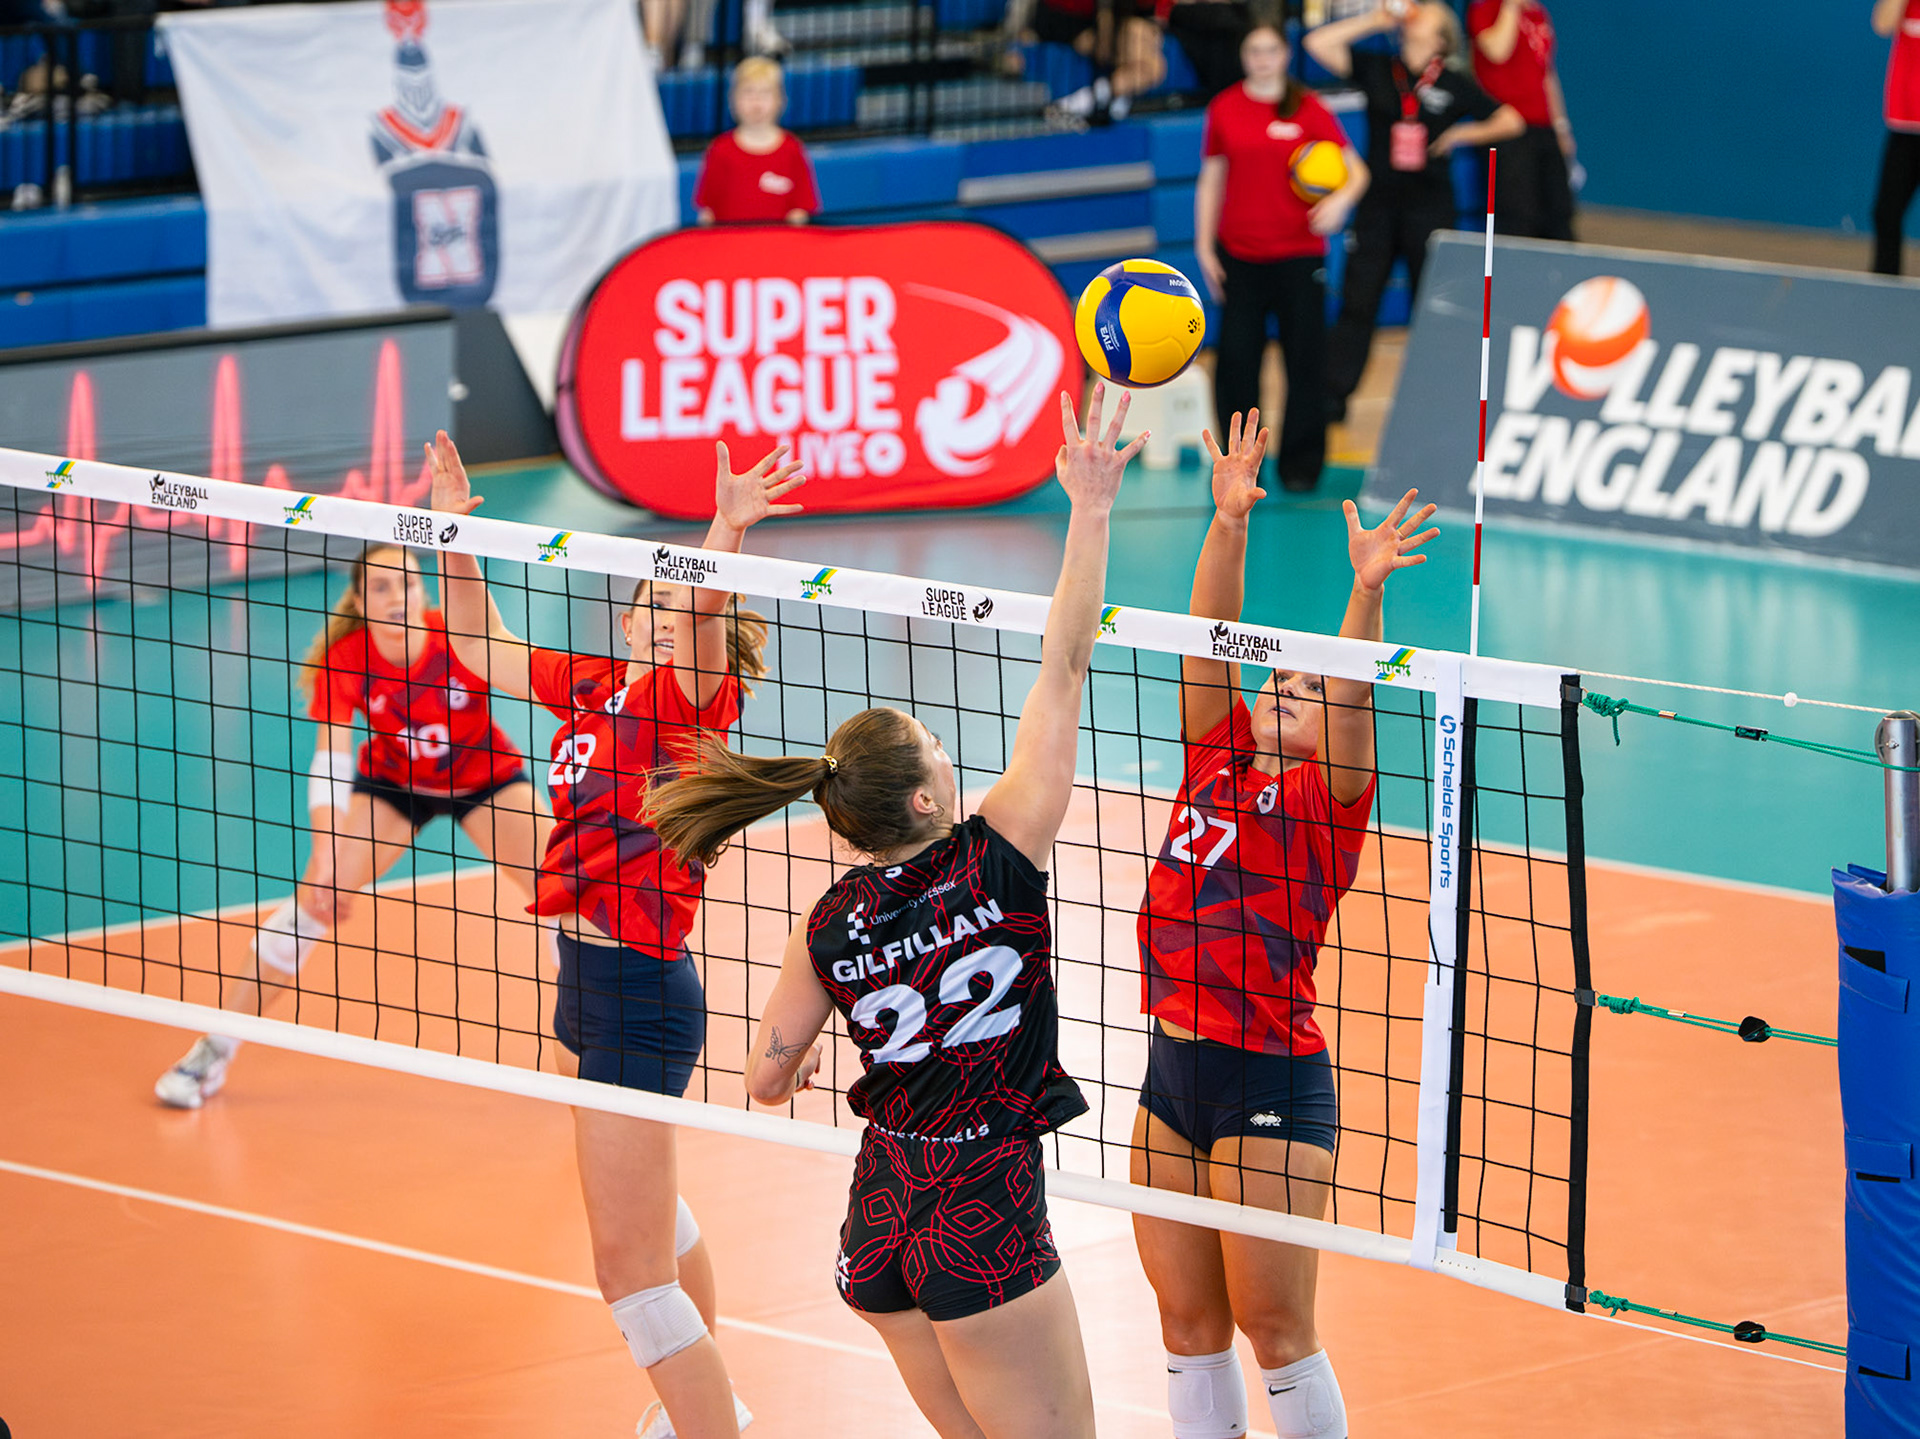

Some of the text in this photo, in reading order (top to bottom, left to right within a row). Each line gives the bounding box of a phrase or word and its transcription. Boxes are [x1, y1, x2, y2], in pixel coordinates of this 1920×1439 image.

[654, 276, 897, 358] SUPER
[621, 354, 901, 442] LEAGUE
[149, 474, 209, 500] VOLLEYBALL
[1467, 411, 1871, 538] ENGLAND
[151, 492, 198, 510] ENGLAND
[397, 512, 433, 531] SUPER
[393, 526, 434, 546] LEAGUE
[652, 546, 718, 574] VOLLEYBALL
[654, 565, 706, 584] ENGLAND
[925, 586, 966, 607] SUPER
[921, 600, 968, 621] LEAGUE
[1209, 622, 1283, 652] VOLLEYBALL
[1212, 643, 1269, 663] ENGLAND
[1374, 659, 1411, 677] HUCK
[396, 723, 451, 761] 10
[1438, 737, 1456, 889] Schelde Sports
[1170, 806, 1238, 871] 27
[927, 880, 957, 899] Essex
[831, 898, 1004, 983] GILFILLAN
[851, 945, 1023, 1064] 22
